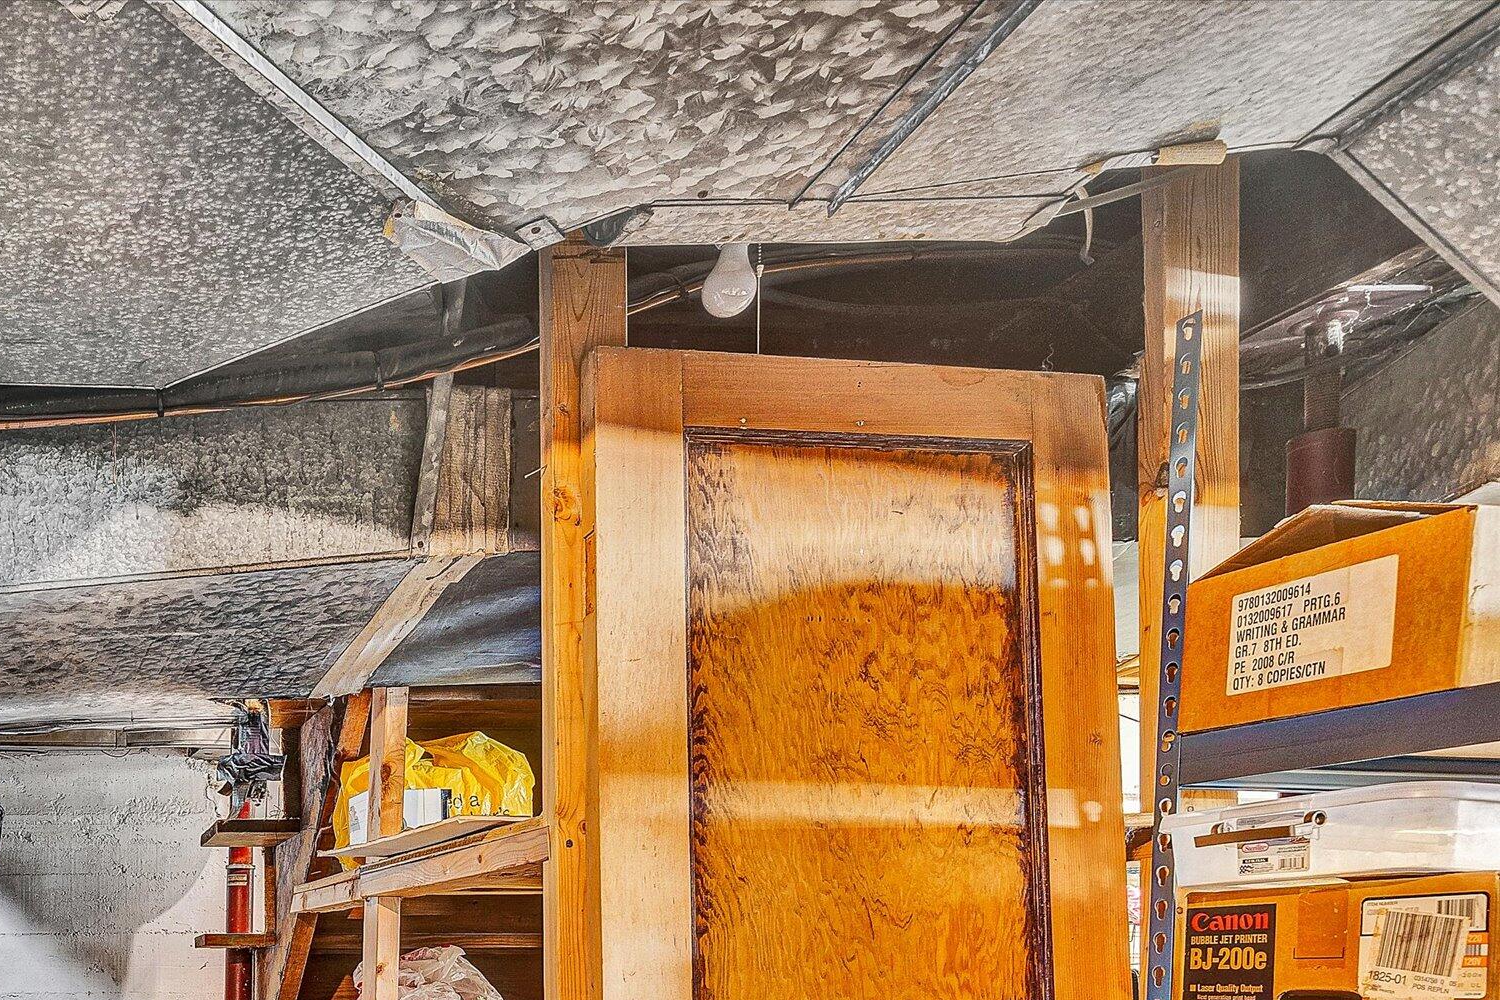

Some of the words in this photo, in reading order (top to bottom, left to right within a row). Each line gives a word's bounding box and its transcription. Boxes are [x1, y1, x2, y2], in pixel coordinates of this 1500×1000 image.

[1238, 582, 1311, 612] 9780132009614
[1237, 603, 1293, 628] 0132009617
[1303, 592, 1341, 613] PRTG.6
[1236, 622, 1278, 643] WRITING
[1281, 620, 1288, 634] &
[1292, 607, 1346, 631] GRAMMAR
[1235, 643, 1257, 659] GR.7
[1263, 637, 1282, 653] 8TH
[1286, 634, 1302, 648] ED.
[1234, 660, 1246, 675] PE
[1252, 655, 1274, 671] 2008
[1278, 651, 1295, 666] C/R
[1233, 675, 1254, 691] QTY:
[1257, 673, 1264, 686] 8
[1266, 660, 1326, 685] COPIES/CTN
[469, 795, 480, 807] a
[1191, 912, 1269, 932] Canon
[1190, 935, 1219, 945] BUBBLE
[1220, 934, 1234, 944] JET
[1234, 933, 1268, 944] PRINTER
[1189, 946, 1268, 970] BJ-200e
[1197, 984, 1215, 993] Laser
[1216, 984, 1239, 994] Quality
[1240, 984, 1264, 994] Output
[1368, 970, 1407, 985] 1825-01
